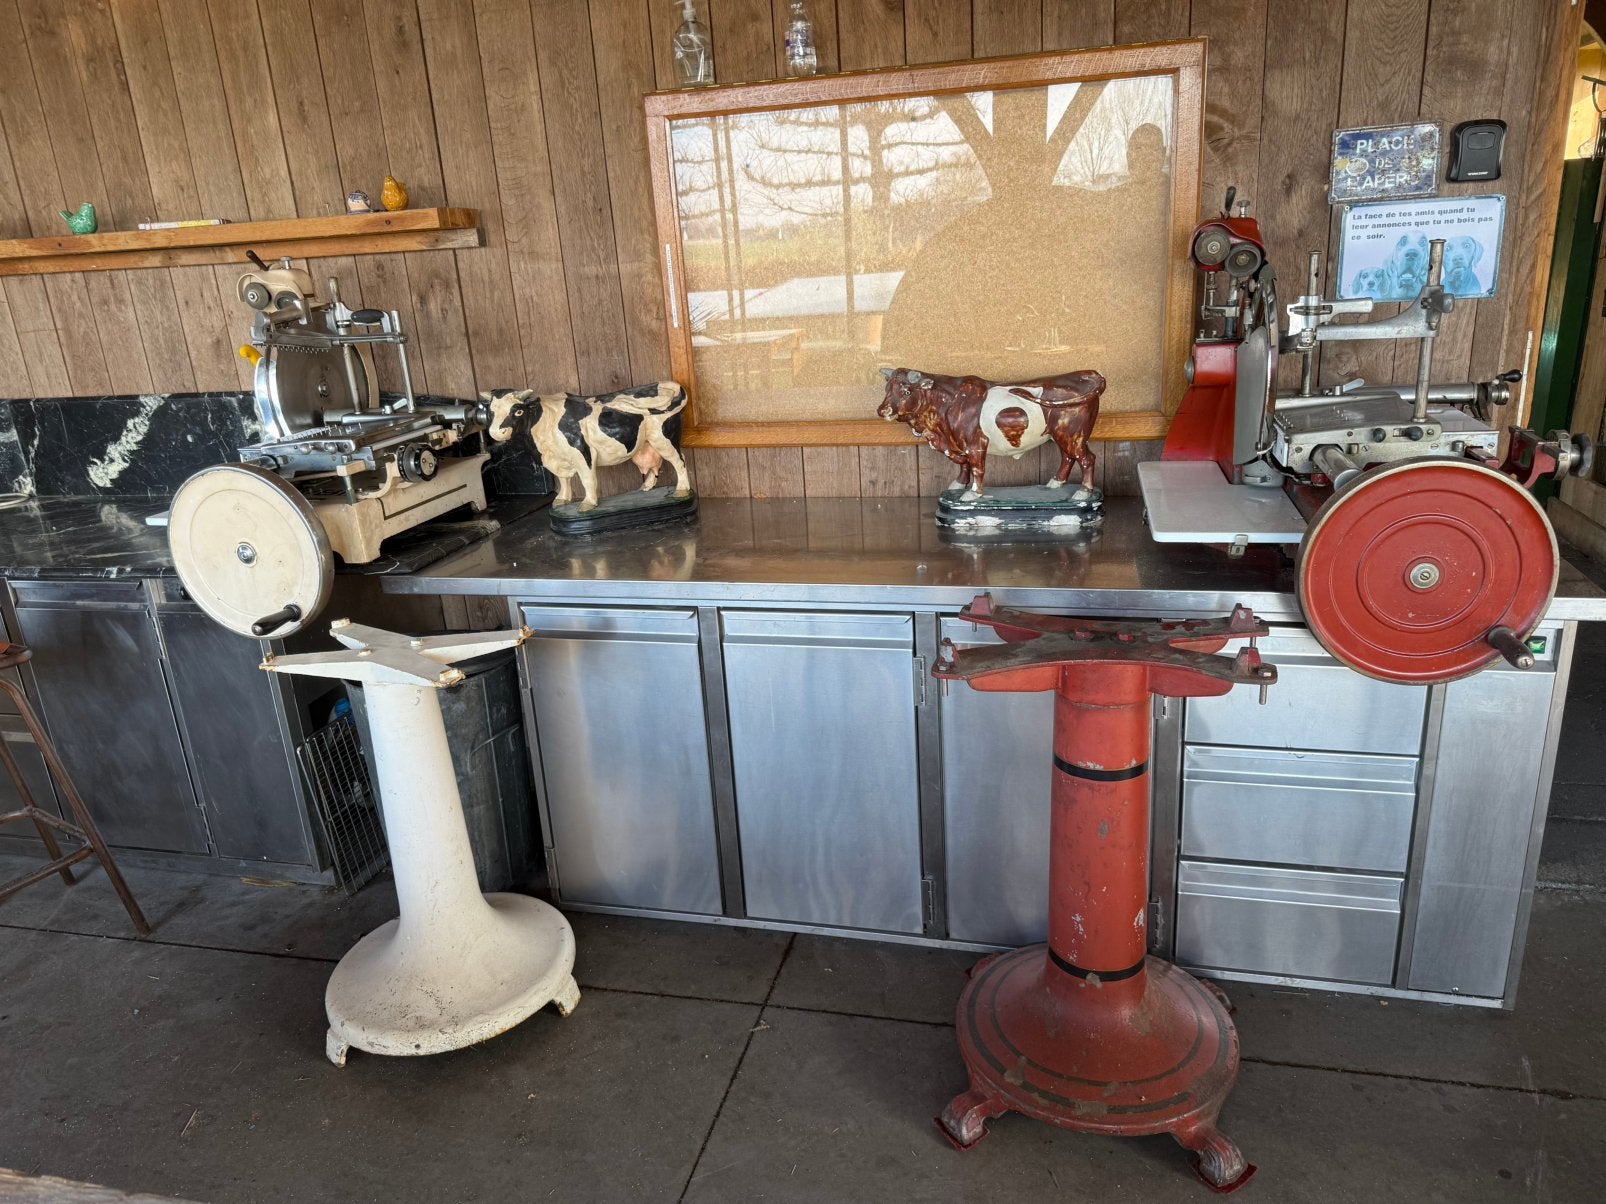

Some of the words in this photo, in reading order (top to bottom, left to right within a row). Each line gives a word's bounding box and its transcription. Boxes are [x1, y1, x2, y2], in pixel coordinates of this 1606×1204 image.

[1364, 212, 1383, 220] face
[1385, 211, 1396, 219] de
[1414, 209, 1435, 217] amis
[1437, 207, 1464, 216] quand
[1371, 220, 1412, 229] annonces
[1414, 219, 1430, 227] que
[1457, 216, 1475, 224] bois
[1366, 232, 1386, 240] soir.
